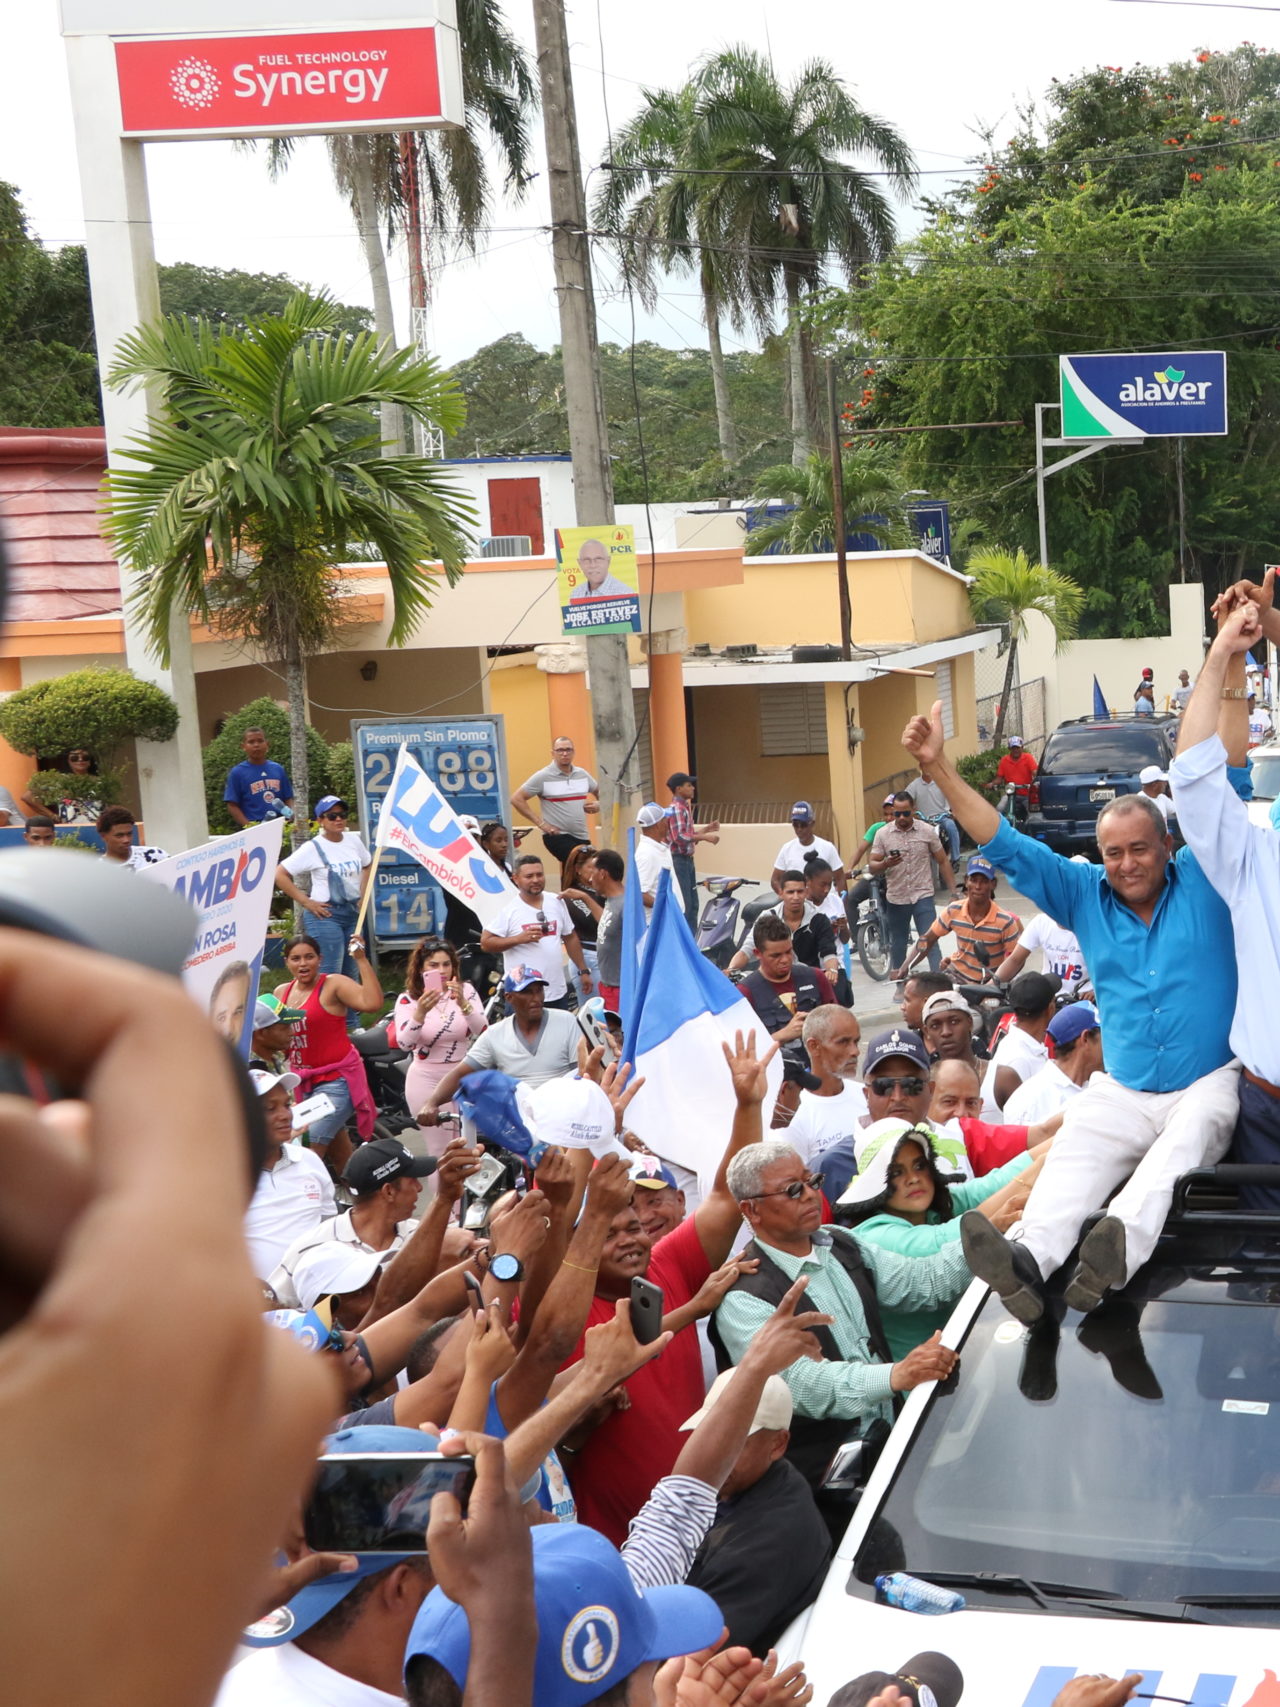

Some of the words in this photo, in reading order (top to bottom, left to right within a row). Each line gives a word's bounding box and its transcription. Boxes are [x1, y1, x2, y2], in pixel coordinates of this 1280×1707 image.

[259, 54, 292, 66] FUEL
[296, 50, 387, 65] TECHNOLOGY
[233, 64, 389, 107] Synergy
[1119, 376, 1213, 402] alaver
[610, 545, 632, 554] PCR
[562, 567, 581, 575] VOTA
[567, 574, 577, 587] 9
[564, 610, 590, 624] JOSE
[591, 604, 638, 619] ESTEVEZ
[571, 617, 606, 628] ALCALDE
[366, 731, 421, 745] Premium
[424, 730, 445, 743] Sin
[447, 730, 489, 743] Plomo
[174, 846, 267, 909] AMBIO
[378, 873, 419, 886] Diesel
[381, 892, 433, 933] 14
[203, 921, 237, 950] ROSA
[875, 1041, 897, 1053] CARLOS
[898, 1041, 917, 1051] GOMEZ
